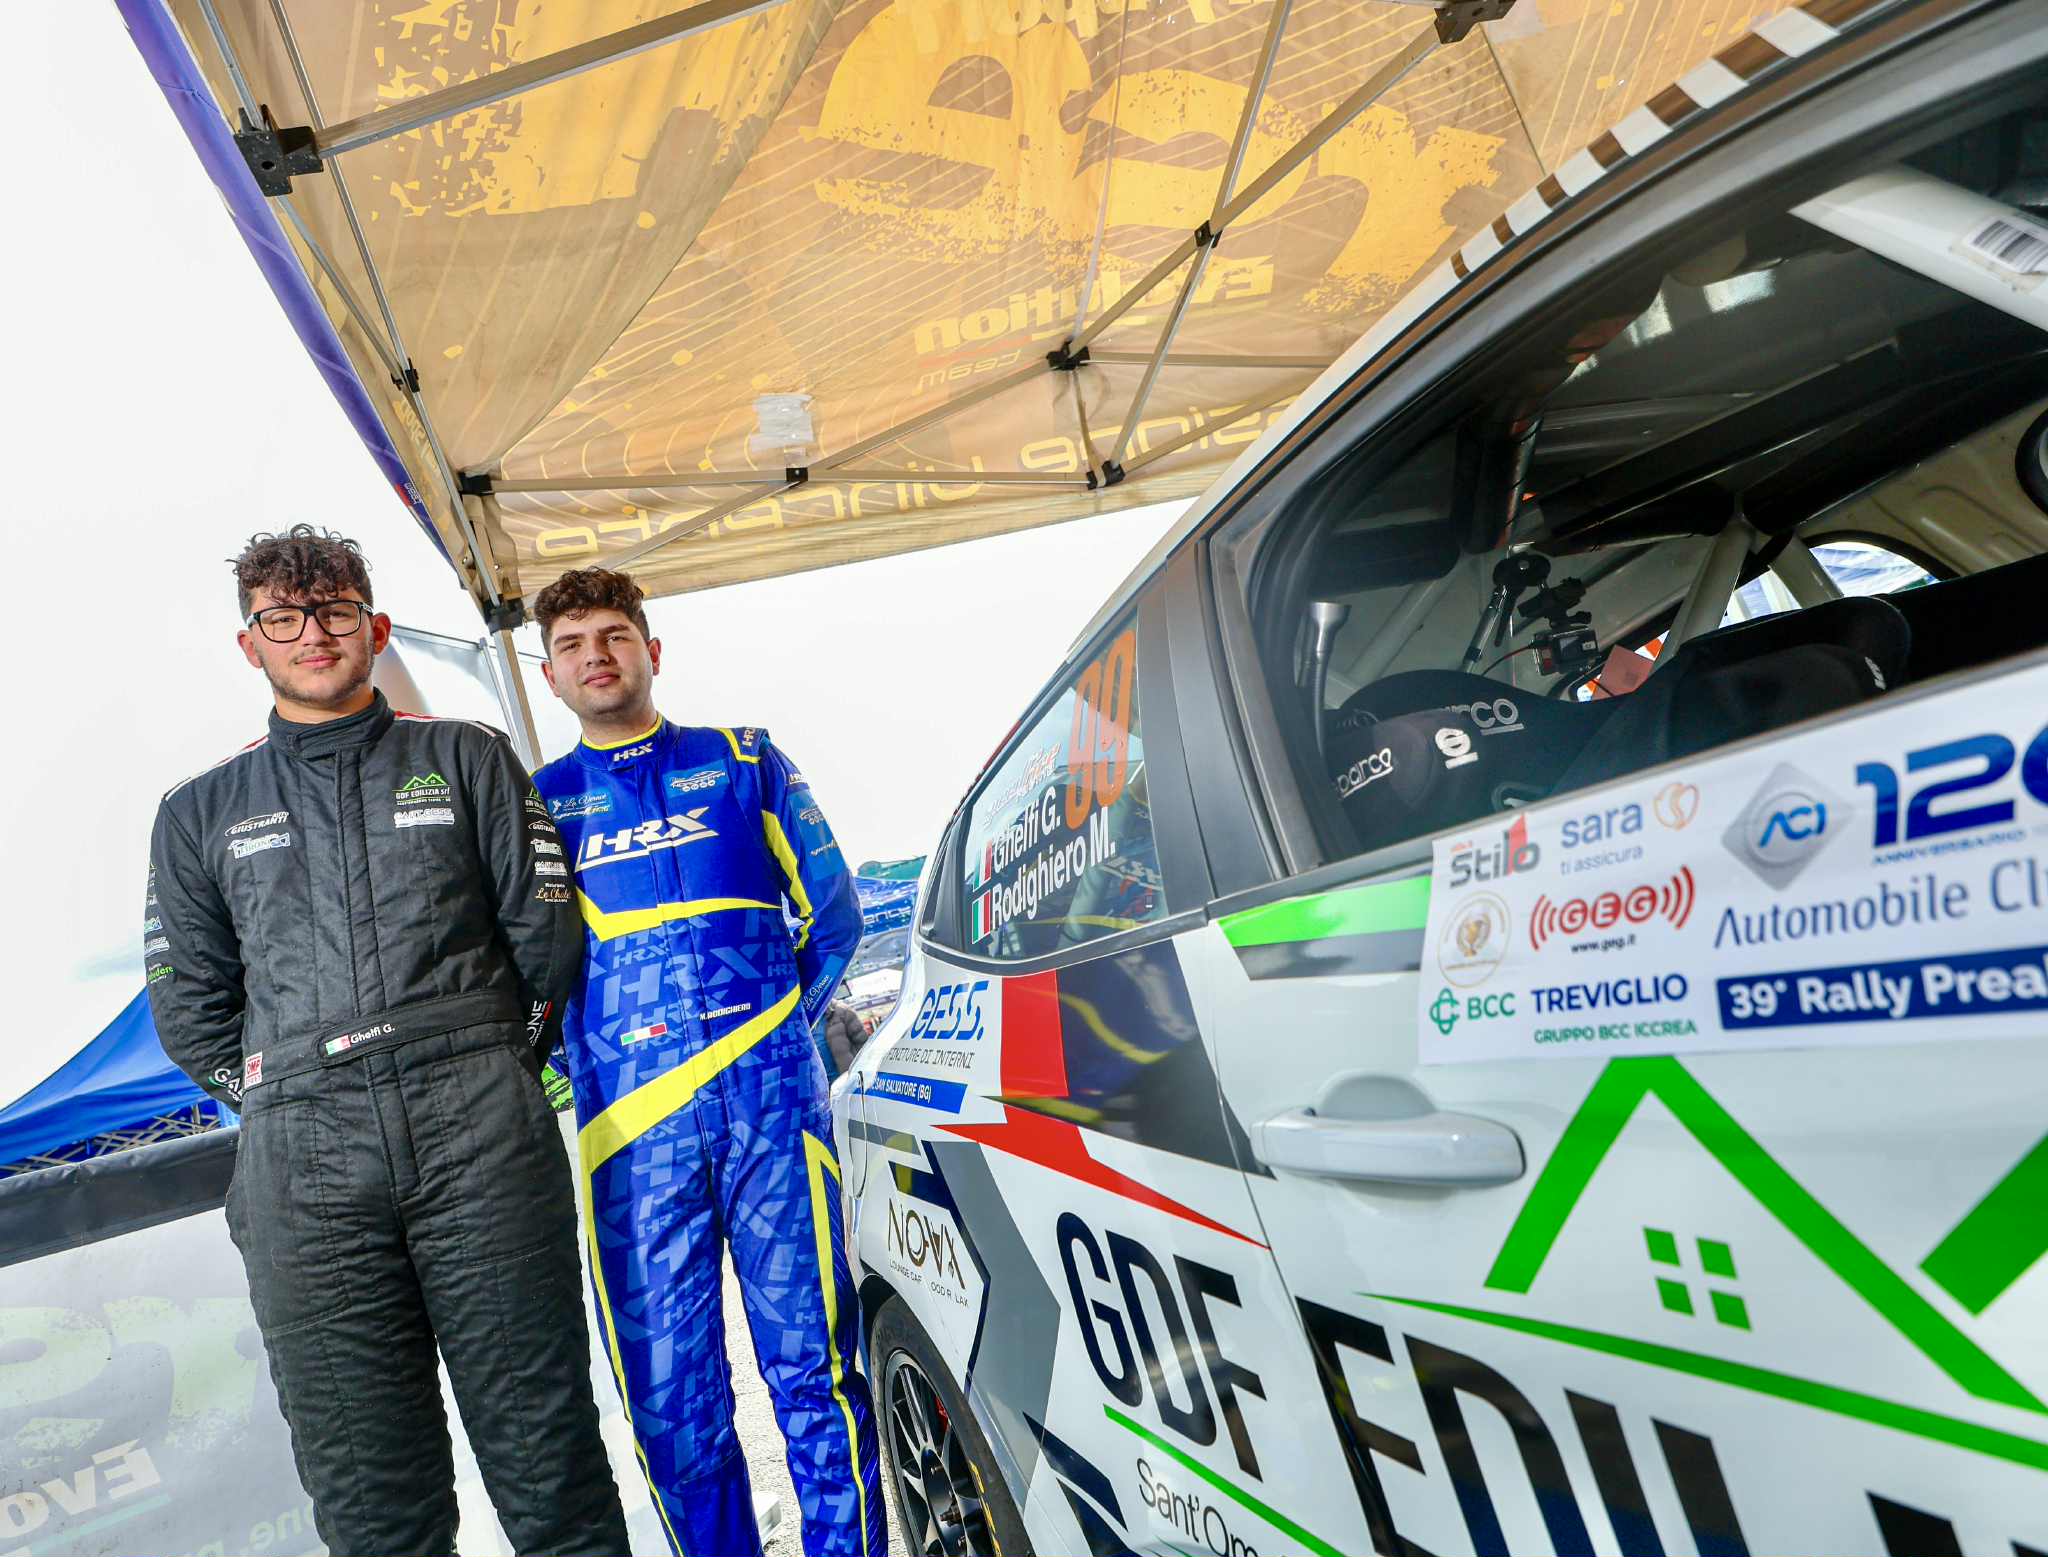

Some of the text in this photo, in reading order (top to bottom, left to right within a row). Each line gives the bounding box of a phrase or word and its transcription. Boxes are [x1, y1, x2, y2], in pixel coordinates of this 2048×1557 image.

[612, 742, 653, 762] HRX
[1041, 786, 1061, 837] G.
[1855, 723, 2048, 850] 12
[585, 806, 710, 859] HRX
[1450, 811, 1541, 889] Stilo
[1560, 802, 1643, 848] sara
[1758, 802, 1828, 849] ACI
[991, 805, 1116, 932] Rodighiero M.
[1574, 844, 1644, 870] assicura
[1714, 857, 2048, 950] Automobile Cl
[1467, 992, 1516, 1021] BCC
[1530, 973, 1689, 1014] TREVIGLIO
[1797, 969, 1912, 1019] Rally
[351, 1023, 395, 1044] Ghelfi G.
[1534, 1018, 1697, 1044] GRUPPO BCC ICCREA
[1056, 1212, 1268, 1483] GDF
[1136, 1457, 1258, 1557] Sant'Om
